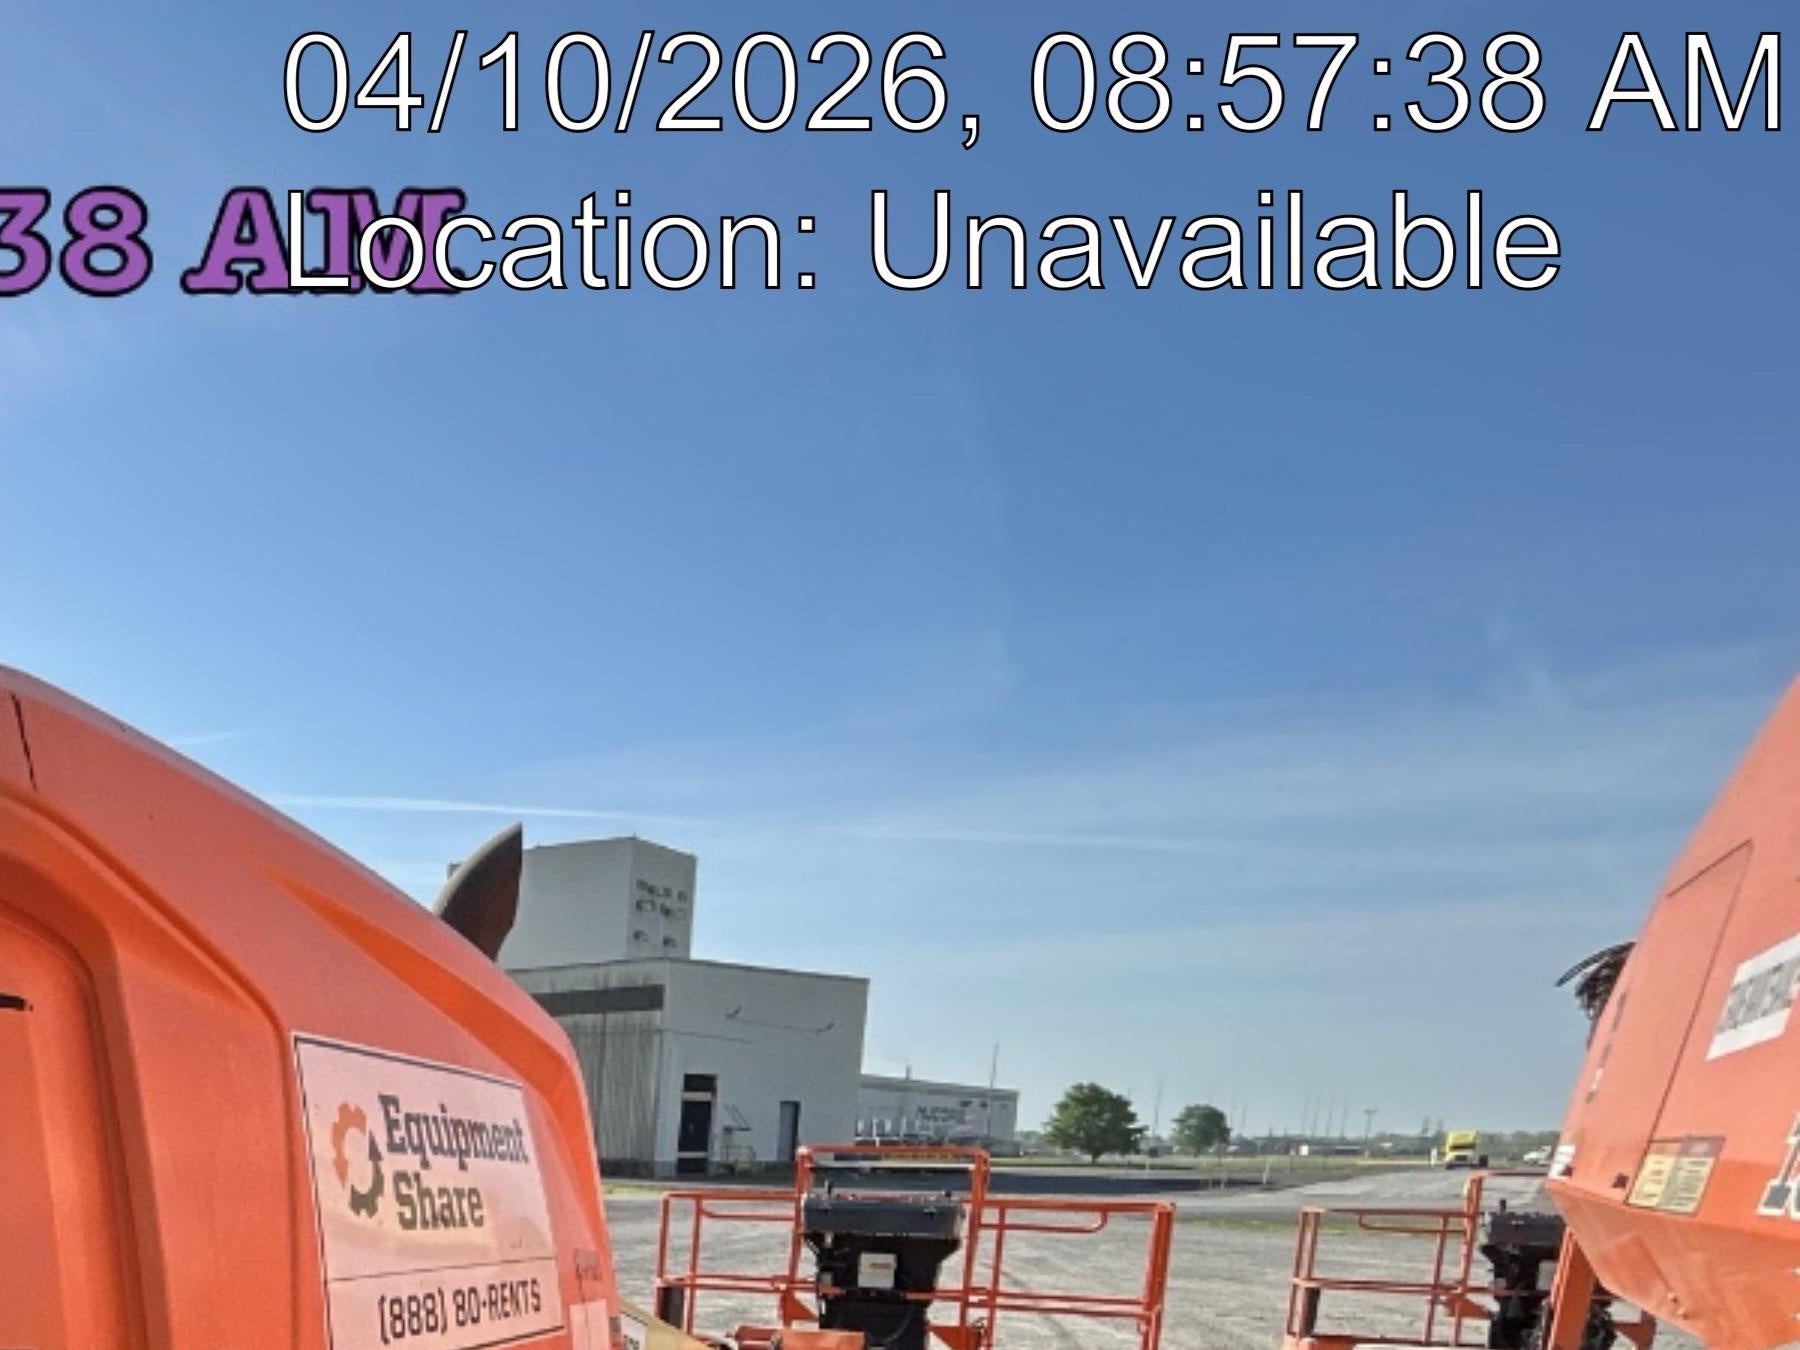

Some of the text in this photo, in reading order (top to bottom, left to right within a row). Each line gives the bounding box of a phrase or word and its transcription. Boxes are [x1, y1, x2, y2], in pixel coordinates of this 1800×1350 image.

[377, 1093, 530, 1171] Equipment
[392, 1170, 485, 1231] Share
[378, 1287, 448, 1345] (888)
